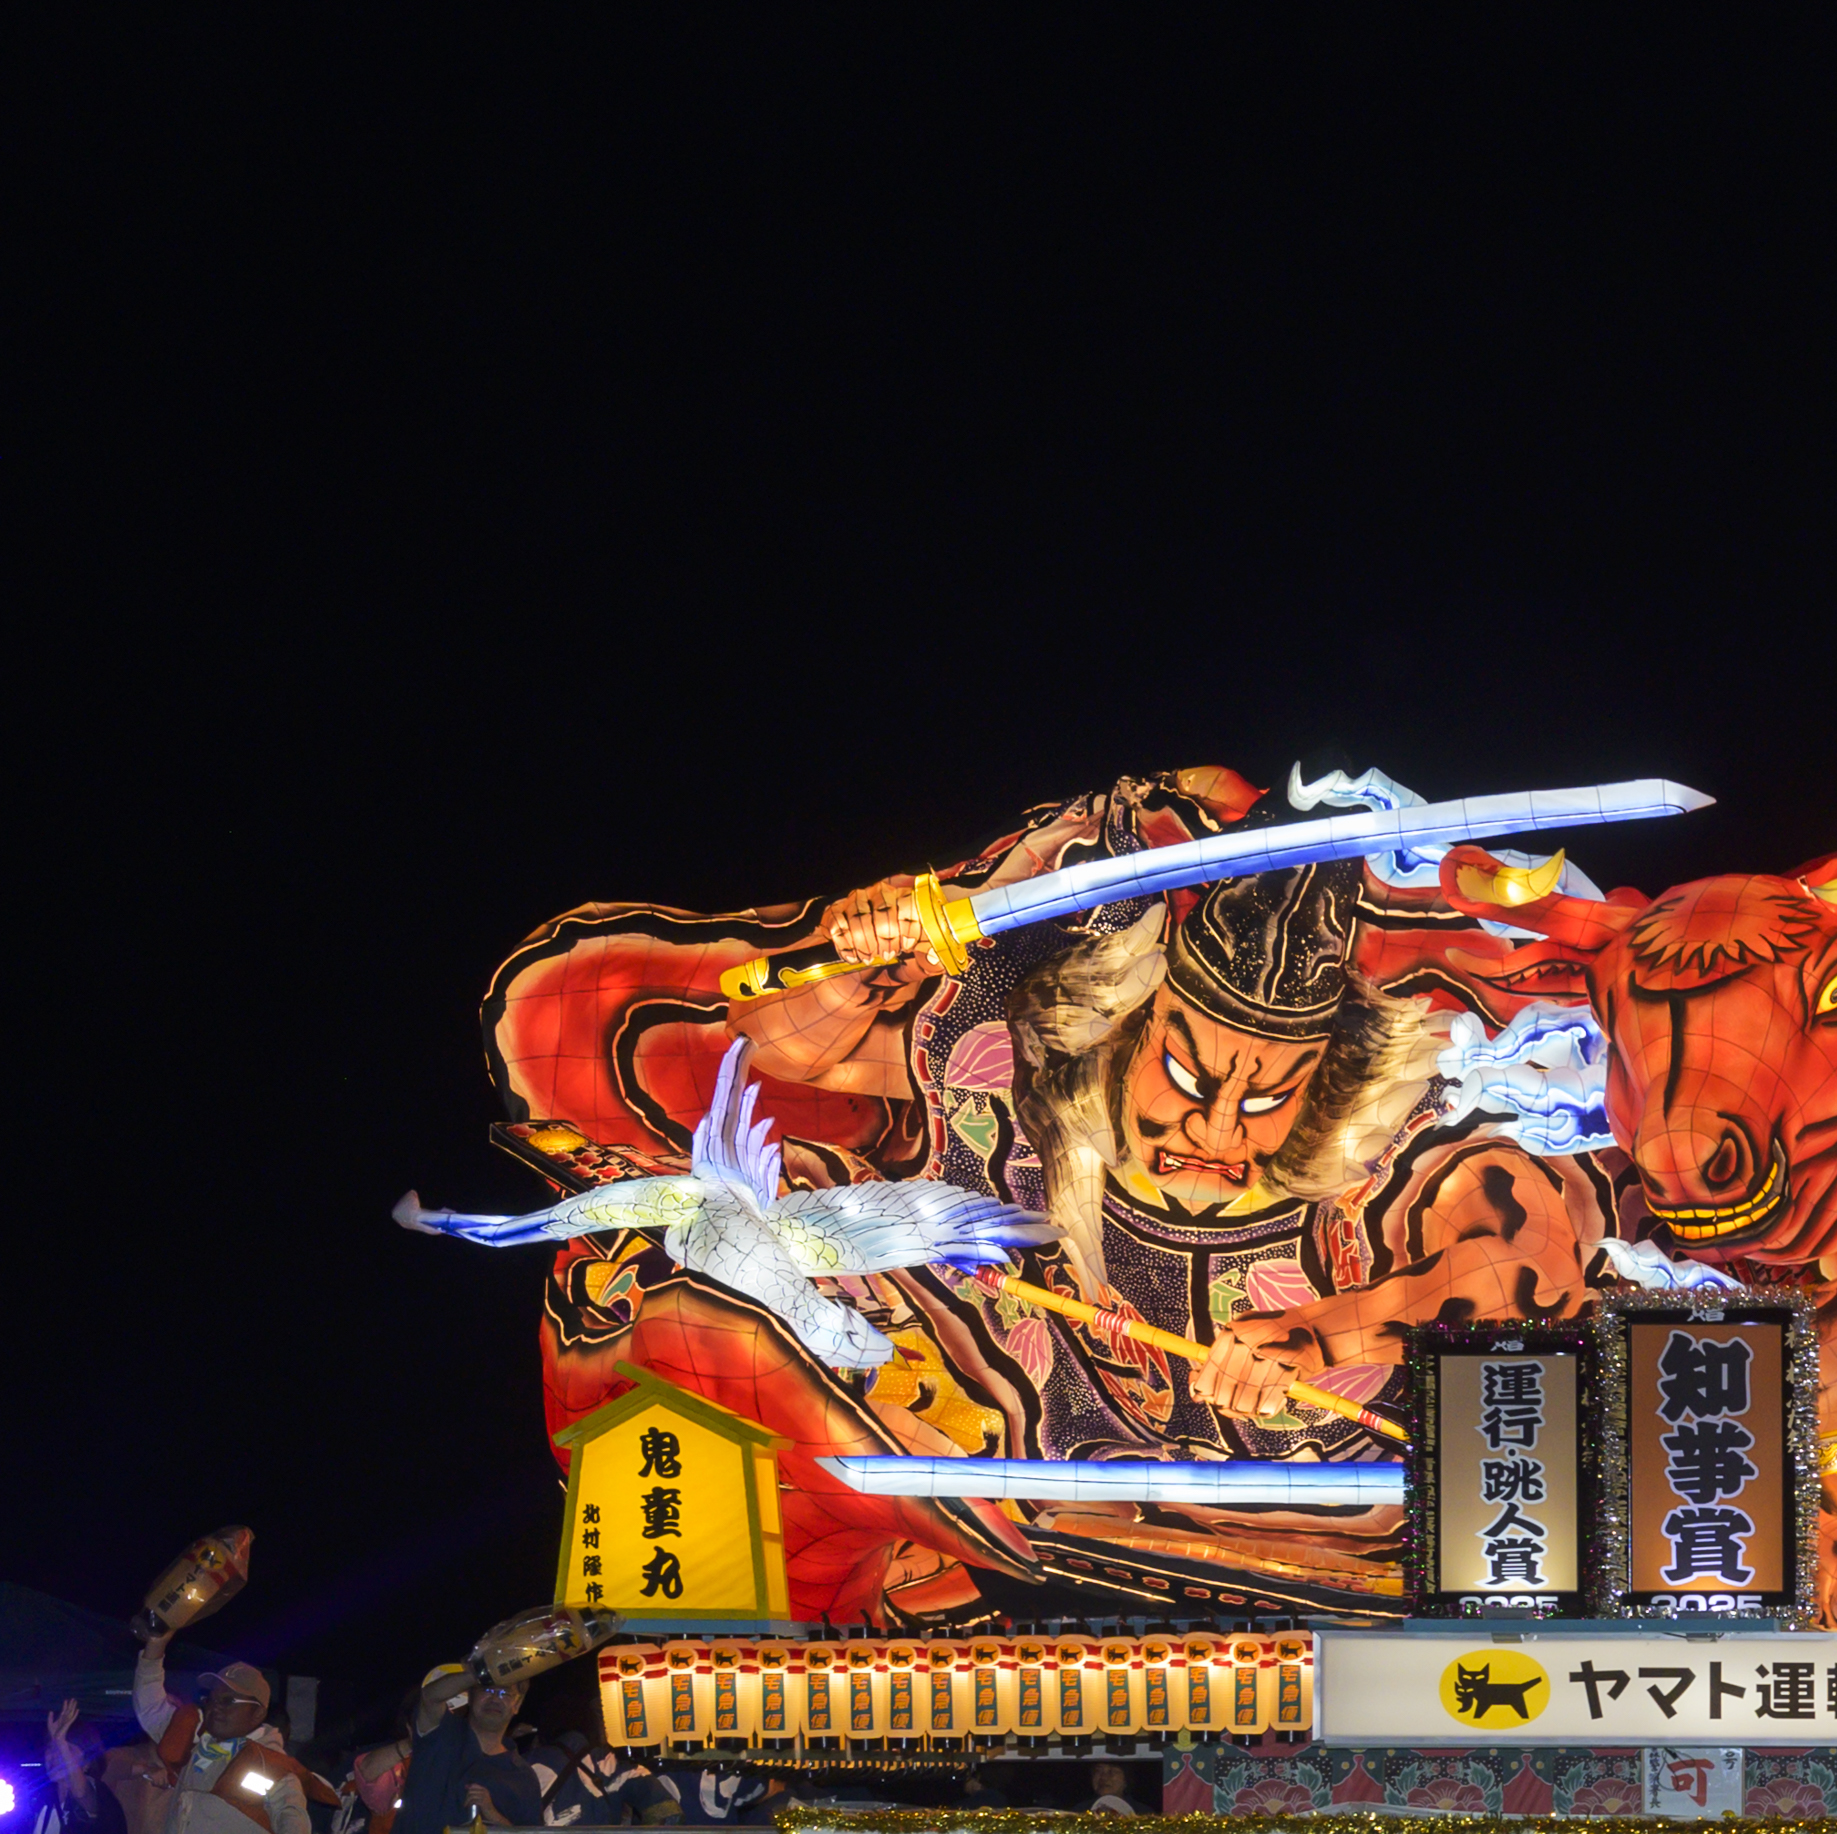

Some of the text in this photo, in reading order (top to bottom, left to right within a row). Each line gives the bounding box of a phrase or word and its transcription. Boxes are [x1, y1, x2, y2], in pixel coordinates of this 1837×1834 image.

[1475, 1360, 1549, 1587] 運行・跳人賞
[1656, 1330, 1759, 1587] 知事賞
[637, 1426, 684, 1600] 鬼童丸
[582, 1503, 604, 1603] 北村隆作
[623, 1681, 644, 1737] 宅急便
[672, 1674, 692, 1730] 宅急便
[716, 1673, 735, 1729] 宅急便
[764, 1674, 784, 1730] 宅急便
[810, 1674, 830, 1729] 宅急便
[852, 1673, 872, 1729] 宅急便
[892, 1673, 911, 1728] 宅急便
[932, 1673, 951, 1729] 宅急便
[976, 1670, 996, 1725] 宅急便
[1020, 1670, 1040, 1725] 宅急便
[1061, 1670, 1081, 1726] 宅急便
[1108, 1670, 1128, 1725] 宅急便
[1148, 1669, 1167, 1724] 宅急便
[1189, 1667, 1209, 1722] 宅急便
[1235, 1668, 1255, 1724] 宅急便
[1280, 1665, 1299, 1721] 宅急便
[1667, 1759, 1715, 1807] 可
